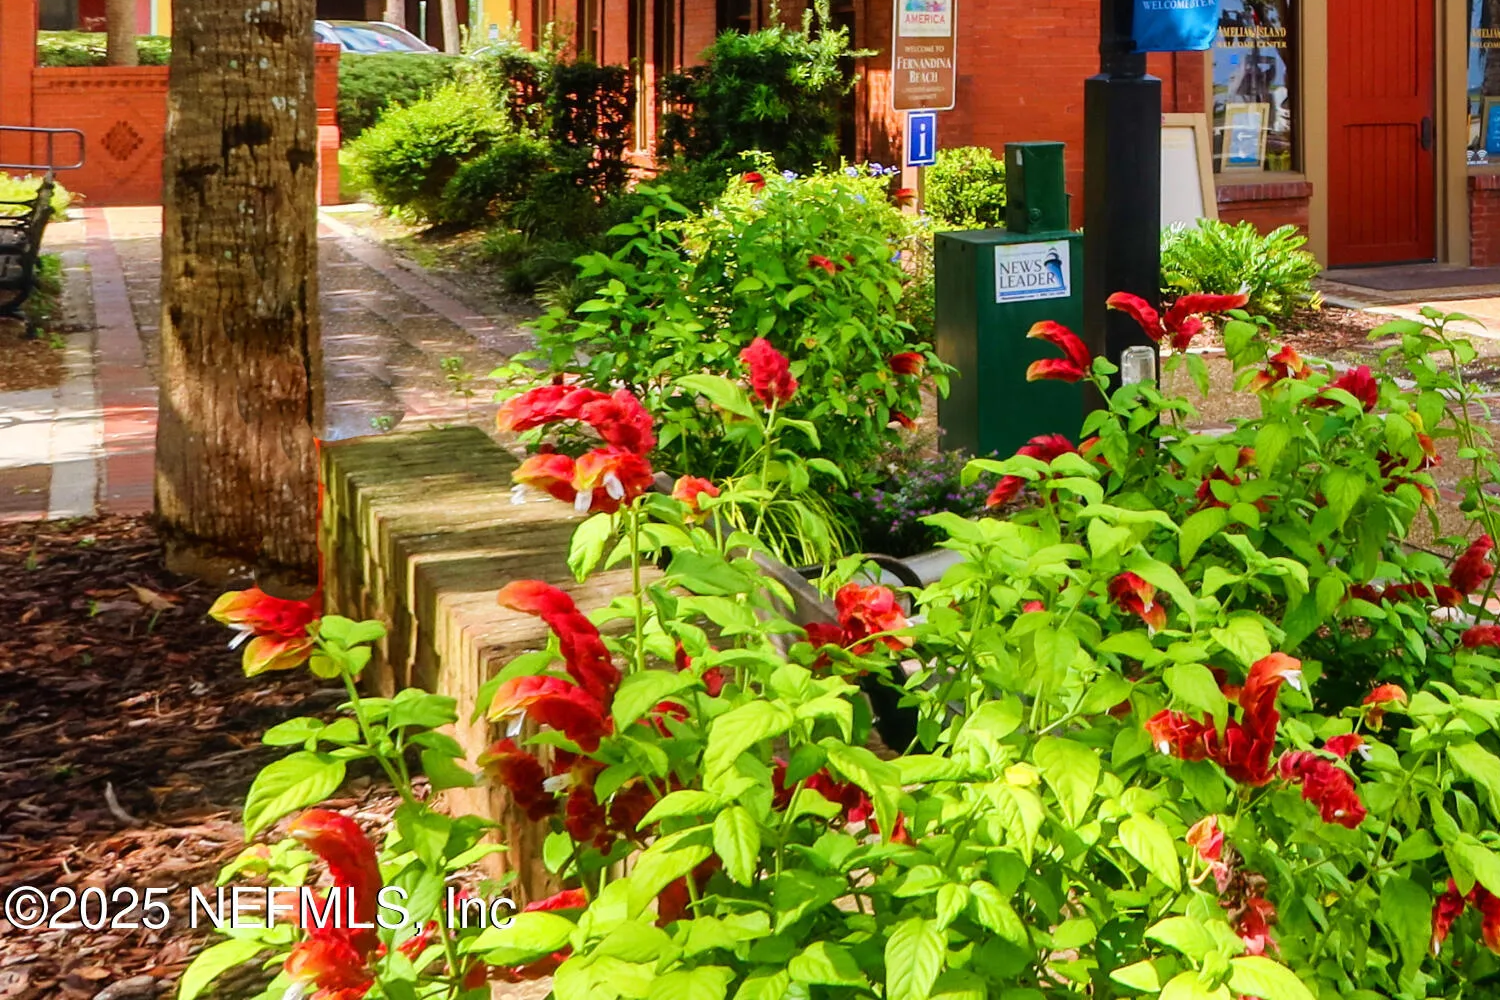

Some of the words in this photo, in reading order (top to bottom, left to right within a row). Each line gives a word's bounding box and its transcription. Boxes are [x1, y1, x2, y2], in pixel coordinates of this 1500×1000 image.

[904, 13, 945, 24] AMERICA
[1256, 25, 1287, 38] ISLAND
[896, 56, 952, 70] FERNANDINA
[909, 70, 938, 84] BEACH
[1000, 259, 1042, 275] NEWS
[1000, 271, 1055, 289] LEADER
